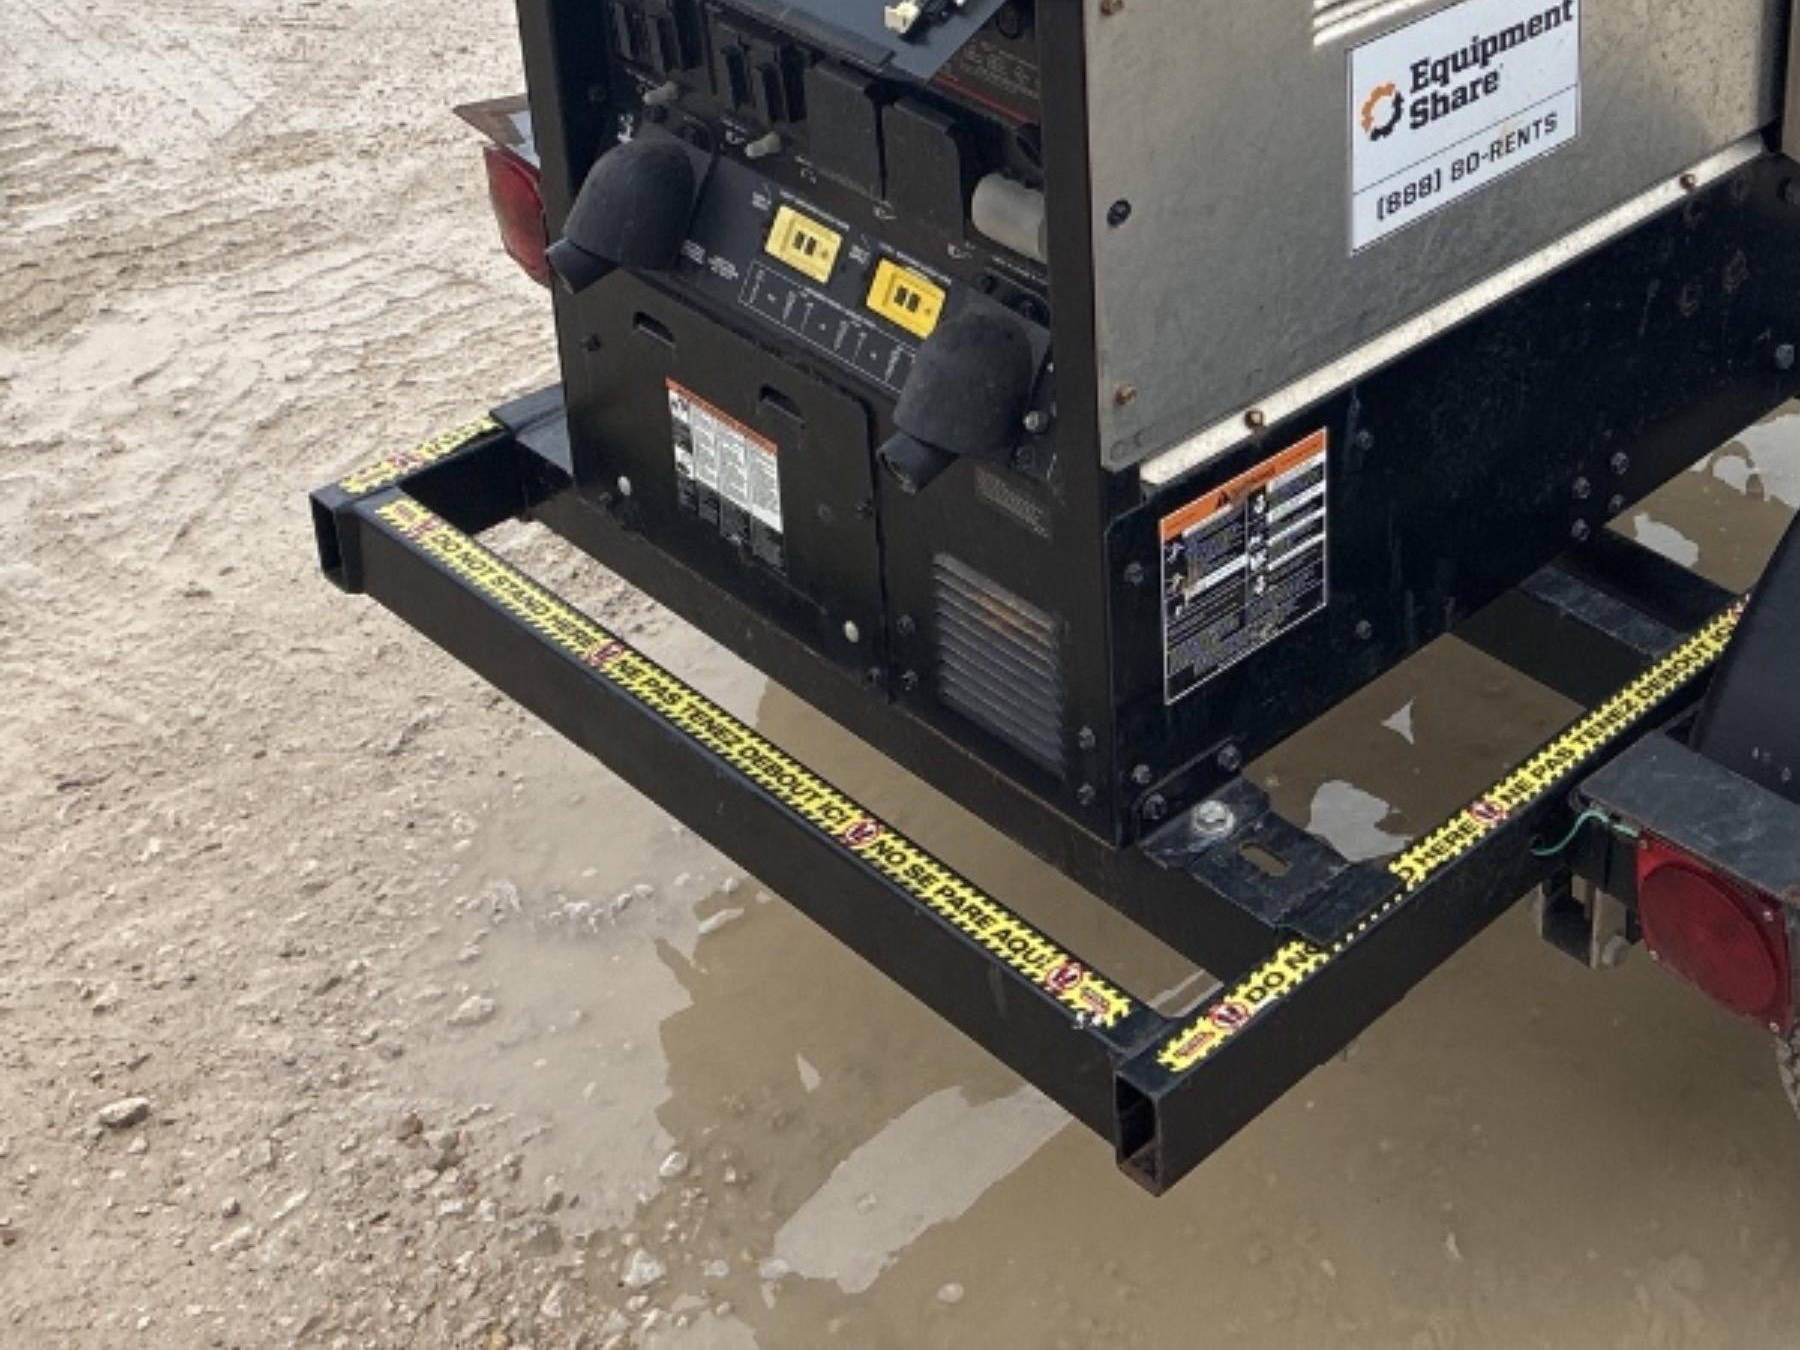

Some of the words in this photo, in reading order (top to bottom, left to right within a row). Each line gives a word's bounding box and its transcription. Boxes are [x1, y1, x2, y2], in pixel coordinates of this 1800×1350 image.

[1409, 70, 1499, 130] Share
[1376, 168, 1442, 221] (888)
[1451, 112, 1558, 183] 80-RENTS
[460, 552, 498, 577] NOT
[610, 658, 644, 681] NE
[639, 676, 684, 706] PAS
[681, 700, 745, 748] TENEZ
[738, 745, 825, 804] DEBOUT
[1529, 747, 1576, 777] PAS
[1634, 644, 1711, 699] DEBOUT
[870, 839, 908, 867] NO
[902, 862, 941, 889] SE
[935, 883, 1000, 931] PARE
[1244, 971, 1286, 1003] DO
